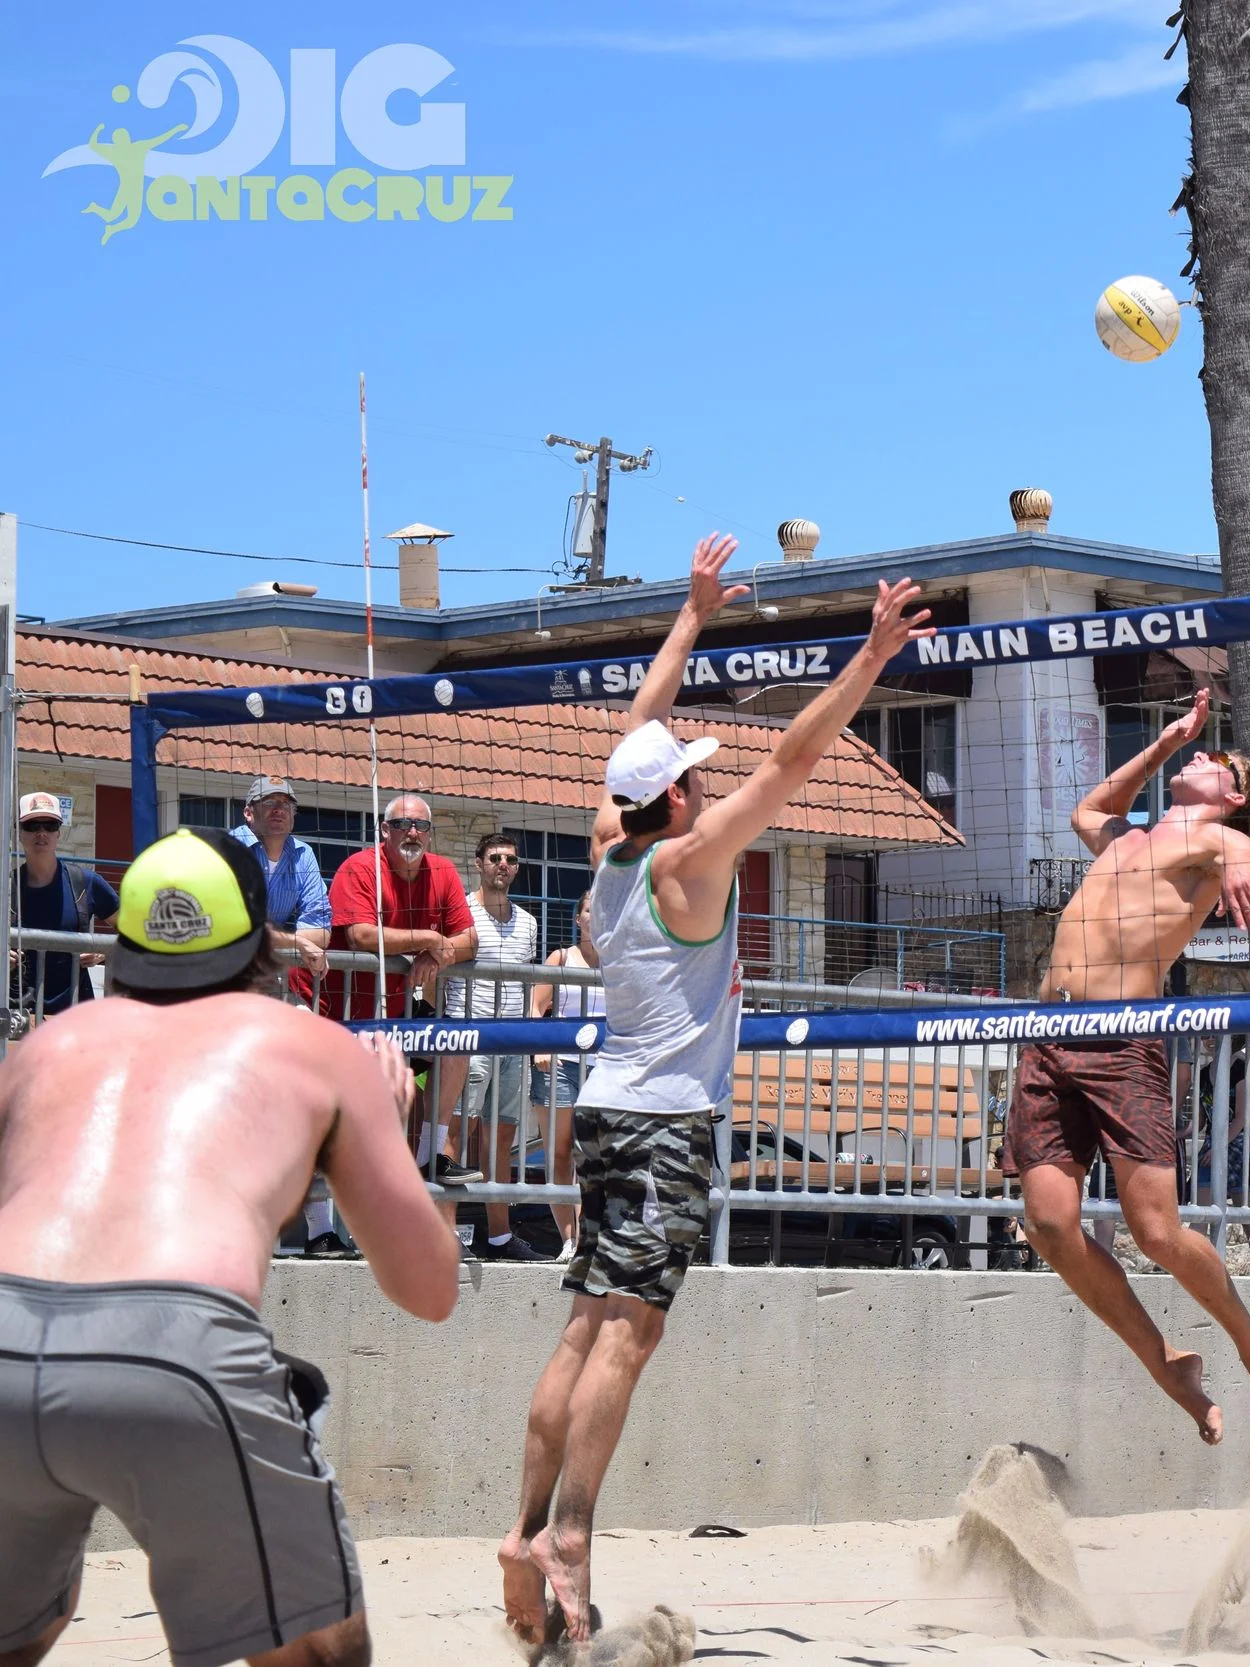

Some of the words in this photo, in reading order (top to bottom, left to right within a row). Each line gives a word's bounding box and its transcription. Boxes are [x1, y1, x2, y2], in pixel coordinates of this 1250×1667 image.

[917, 626, 1029, 664] MAIN
[1050, 608, 1208, 652] BEACH
[602, 656, 719, 693] SATA
[726, 646, 830, 681] CRUZ
[1189, 936, 1211, 946] Bar
[1214, 935, 1224, 946] &
[366, 1024, 479, 1052] harf.com
[916, 1003, 1231, 1042] www.santacruzwharf.com
